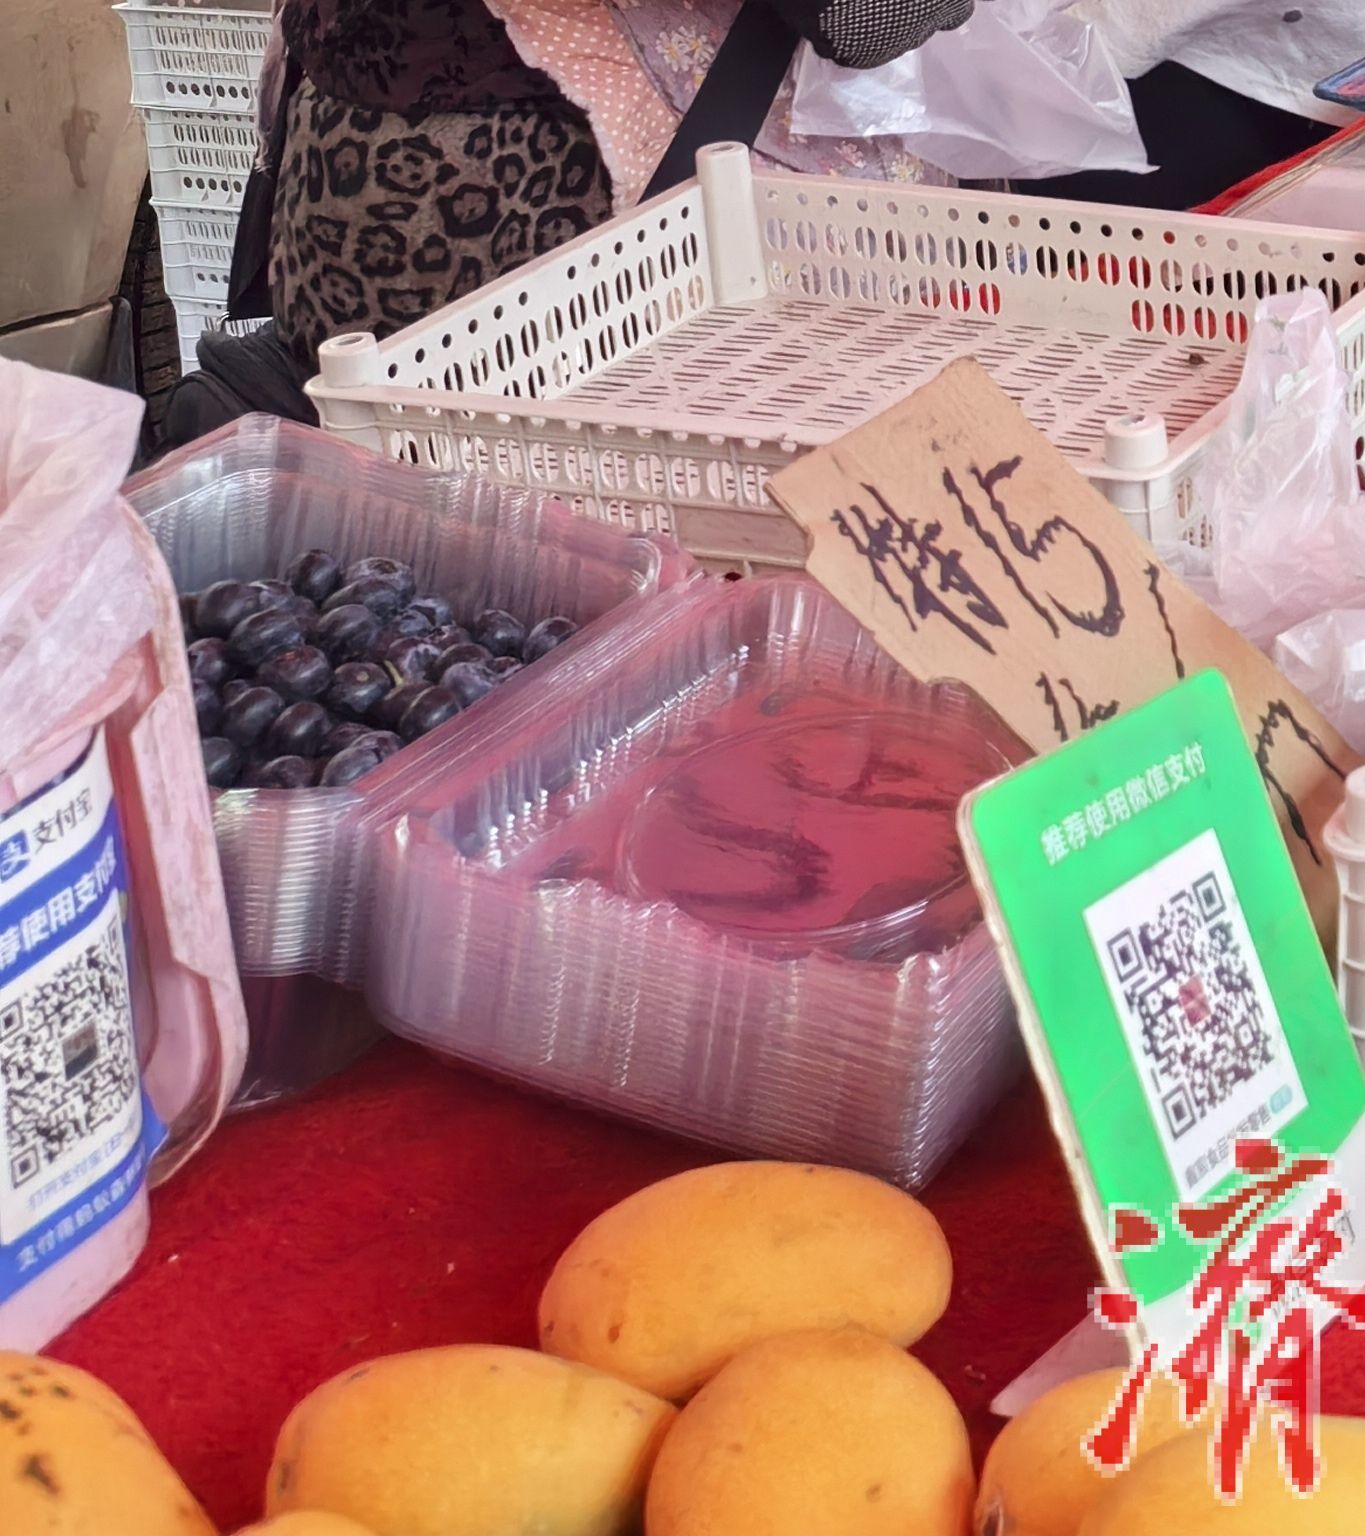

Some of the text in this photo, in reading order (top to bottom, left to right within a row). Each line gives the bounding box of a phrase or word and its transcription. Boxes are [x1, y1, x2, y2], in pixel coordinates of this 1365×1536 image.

[33, 786, 94, 855] 支付宝
[1041, 741, 1206, 867] 推荐使用微信支付
